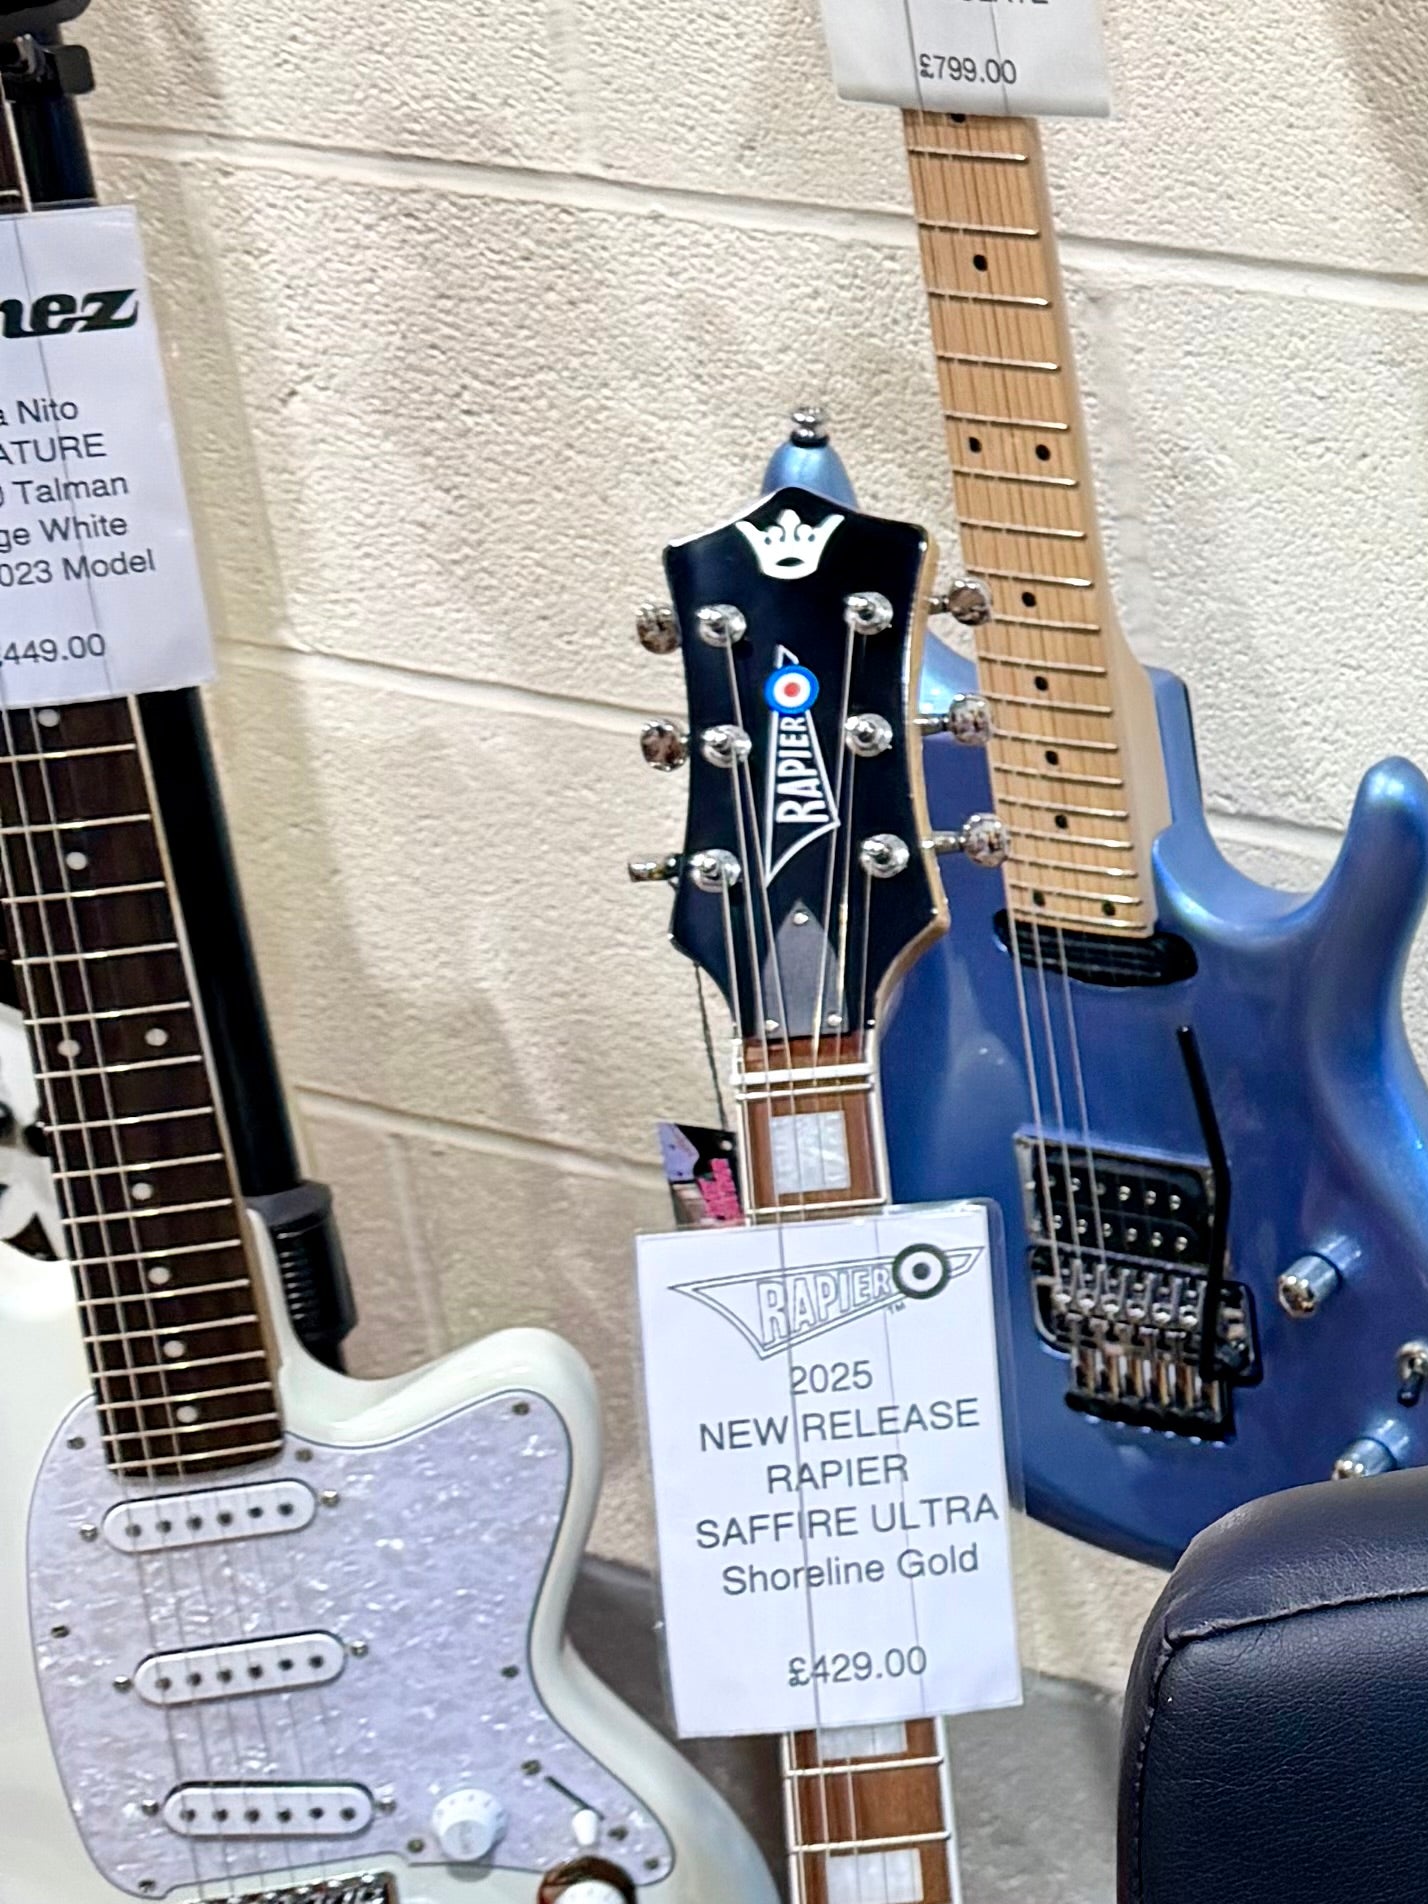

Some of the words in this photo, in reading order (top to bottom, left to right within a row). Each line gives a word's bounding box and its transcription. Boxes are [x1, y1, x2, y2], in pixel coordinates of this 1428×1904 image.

[919, 54, 1019, 86] £799.00
[16, 397, 79, 425] Nito
[12, 475, 129, 506] Talman
[39, 513, 128, 543] White
[62, 548, 156, 582] Model
[775, 715, 829, 823] RAPIER
[756, 1263, 895, 1346] RAPIER
[791, 1359, 874, 1396] 2025
[699, 1415, 789, 1452] NEW
[801, 1398, 981, 1443] RELEASE
[766, 1453, 910, 1494] RAPIER
[695, 1505, 859, 1550] SAFFIRE
[871, 1492, 1000, 1533] ULTRA
[721, 1557, 886, 1596] Shoreline
[896, 1542, 980, 1579] Gold
[787, 1645, 928, 1688] £429.00
